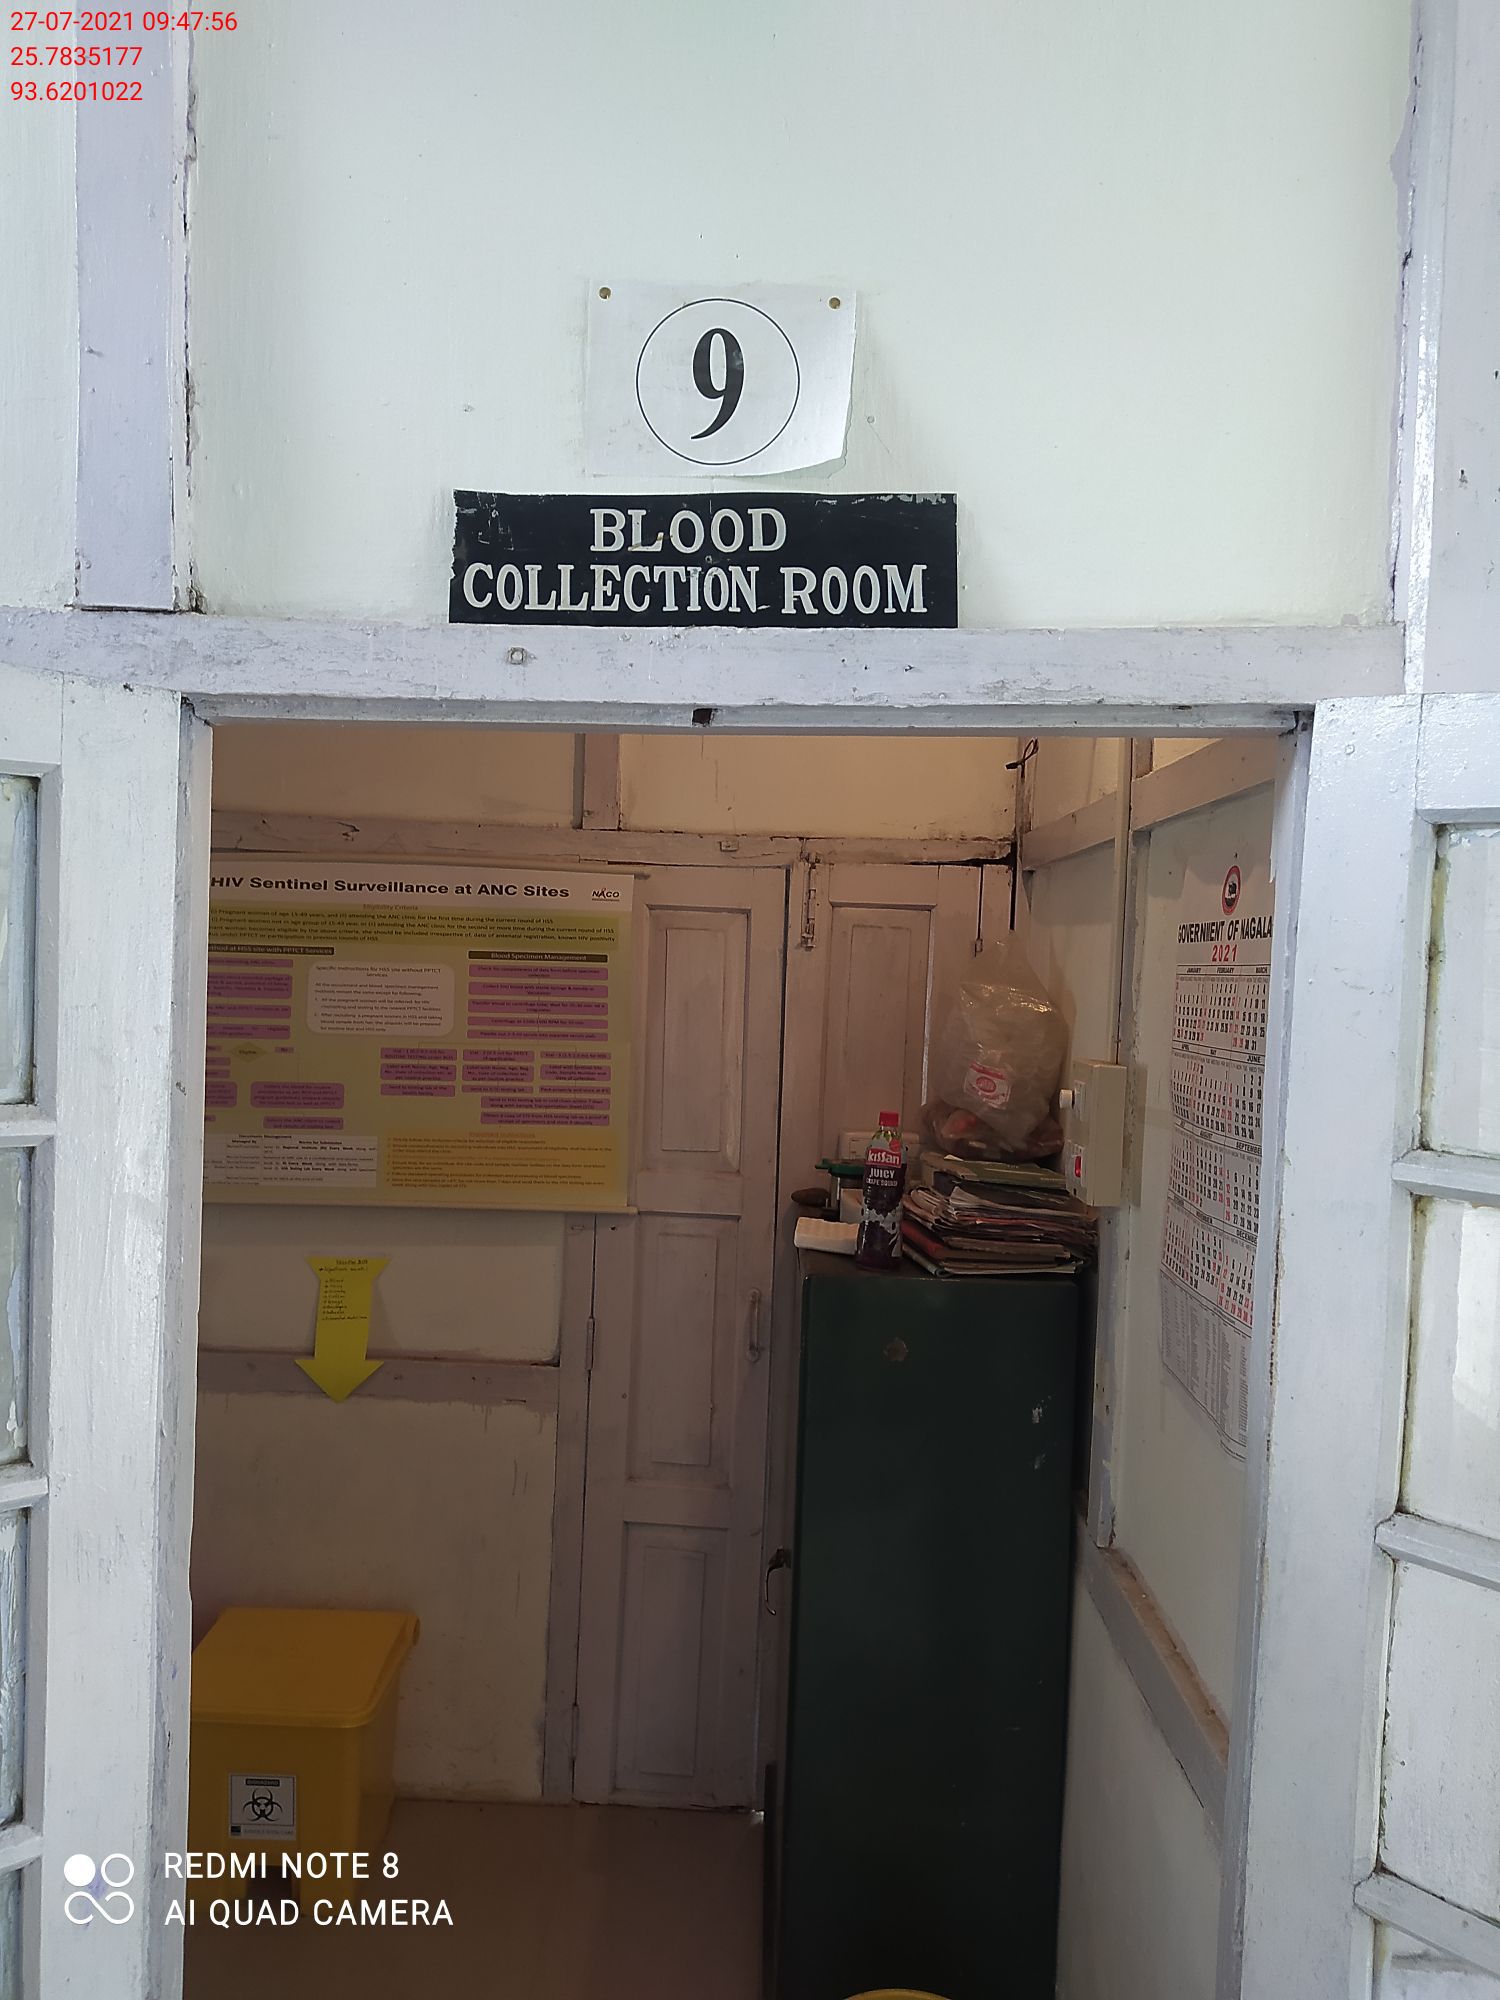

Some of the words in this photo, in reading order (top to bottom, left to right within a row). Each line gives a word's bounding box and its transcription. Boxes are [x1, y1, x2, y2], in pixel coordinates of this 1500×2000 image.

[691, 328, 744, 440] 9
[590, 508, 787, 554] BLOOD
[463, 563, 760, 613] COLLECTION
[781, 564, 927, 615] ROOM
[211, 877, 244, 888] HIV
[250, 877, 328, 891] Sentinel
[335, 880, 448, 894] Surveillance
[455, 884, 472, 894] at
[478, 884, 517, 896] ANC
[524, 885, 570, 897] Sites
[593, 888, 620, 898] NACO
[1228, 920, 1239, 941] OF
[545, 954, 586, 962] Management
[1212, 944, 1237, 962] 2021
[870, 1168, 895, 1178] JUICY
